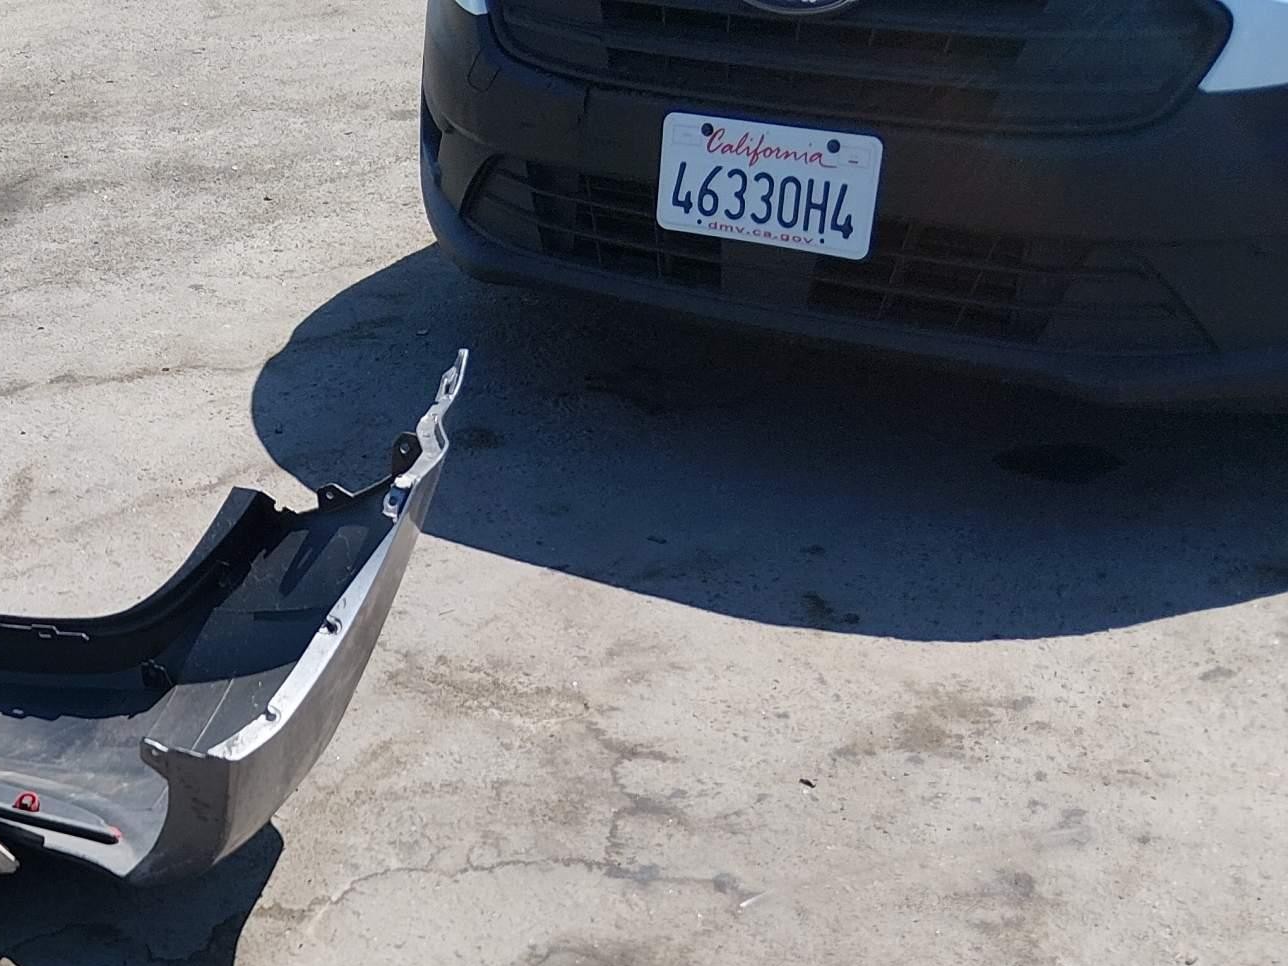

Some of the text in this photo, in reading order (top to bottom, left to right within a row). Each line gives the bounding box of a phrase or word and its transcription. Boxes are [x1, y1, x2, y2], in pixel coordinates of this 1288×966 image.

[706, 128, 837, 168] California
[671, 161, 854, 240] 46330H4
[708, 220, 813, 244] dmv.ca.gov
